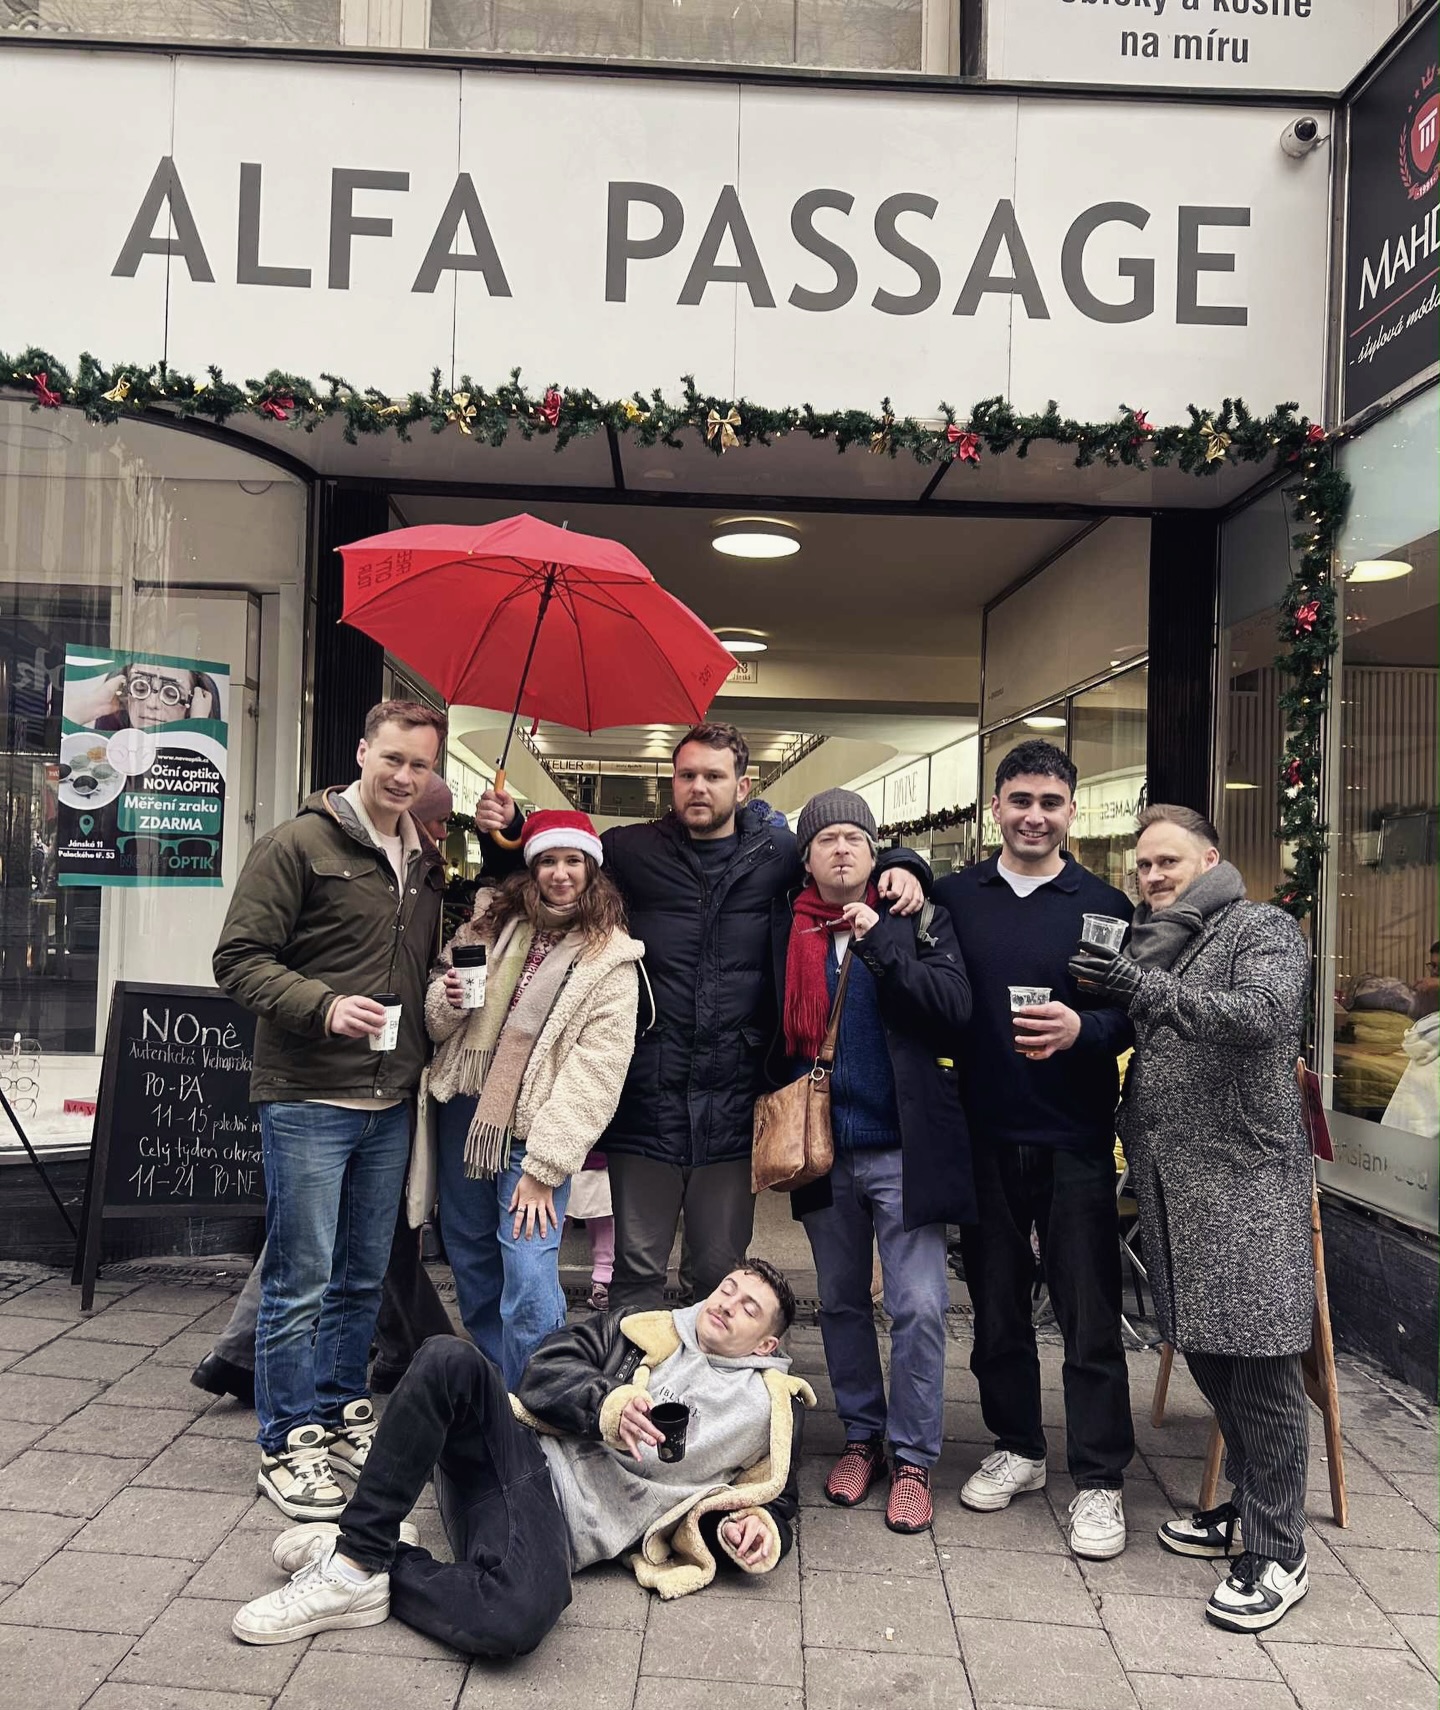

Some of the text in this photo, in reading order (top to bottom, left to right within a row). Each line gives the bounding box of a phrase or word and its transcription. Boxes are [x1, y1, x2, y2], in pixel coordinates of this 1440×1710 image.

[1121, 28, 1249, 63] na míru
[112, 155, 1251, 326] ALFA PASSAGE
[1358, 315, 1404, 364] stylová
[151, 764, 220, 781] Oční optika
[143, 778, 220, 794] NOVAOPTIK
[124, 795, 218, 813] Měření zraku
[139, 815, 203, 831] ZDARMA
[68, 839, 104, 849] Jánská 11
[58, 849, 95, 859] Palackého
[140, 1136, 170, 1167] Celý
[175, 1136, 218, 1167] týden
